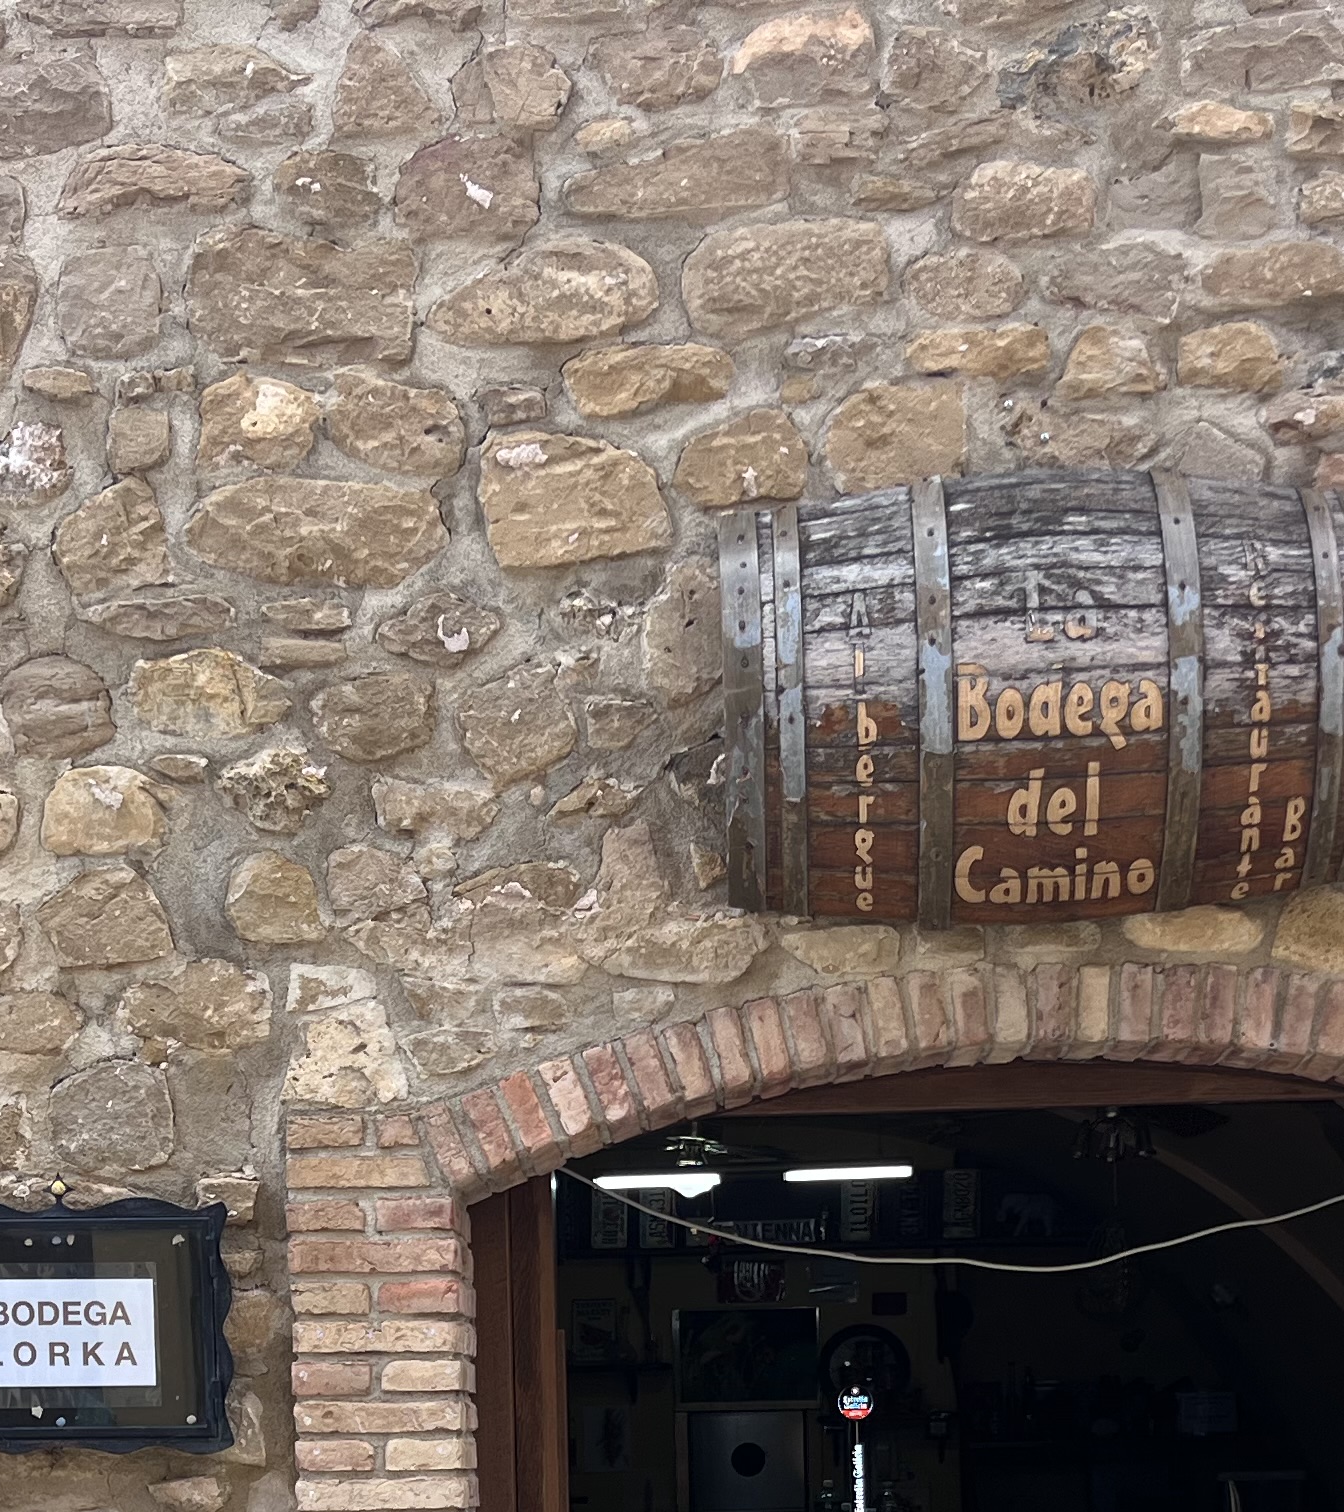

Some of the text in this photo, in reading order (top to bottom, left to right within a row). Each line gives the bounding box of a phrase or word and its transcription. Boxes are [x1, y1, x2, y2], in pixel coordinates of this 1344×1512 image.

[1024, 571, 1097, 643] La
[956, 664, 1163, 750] Bodega
[849, 592, 877, 911] Albergue
[1007, 762, 1100, 837] del
[955, 846, 1155, 905] Camino
[1273, 796, 1305, 891] Bar
